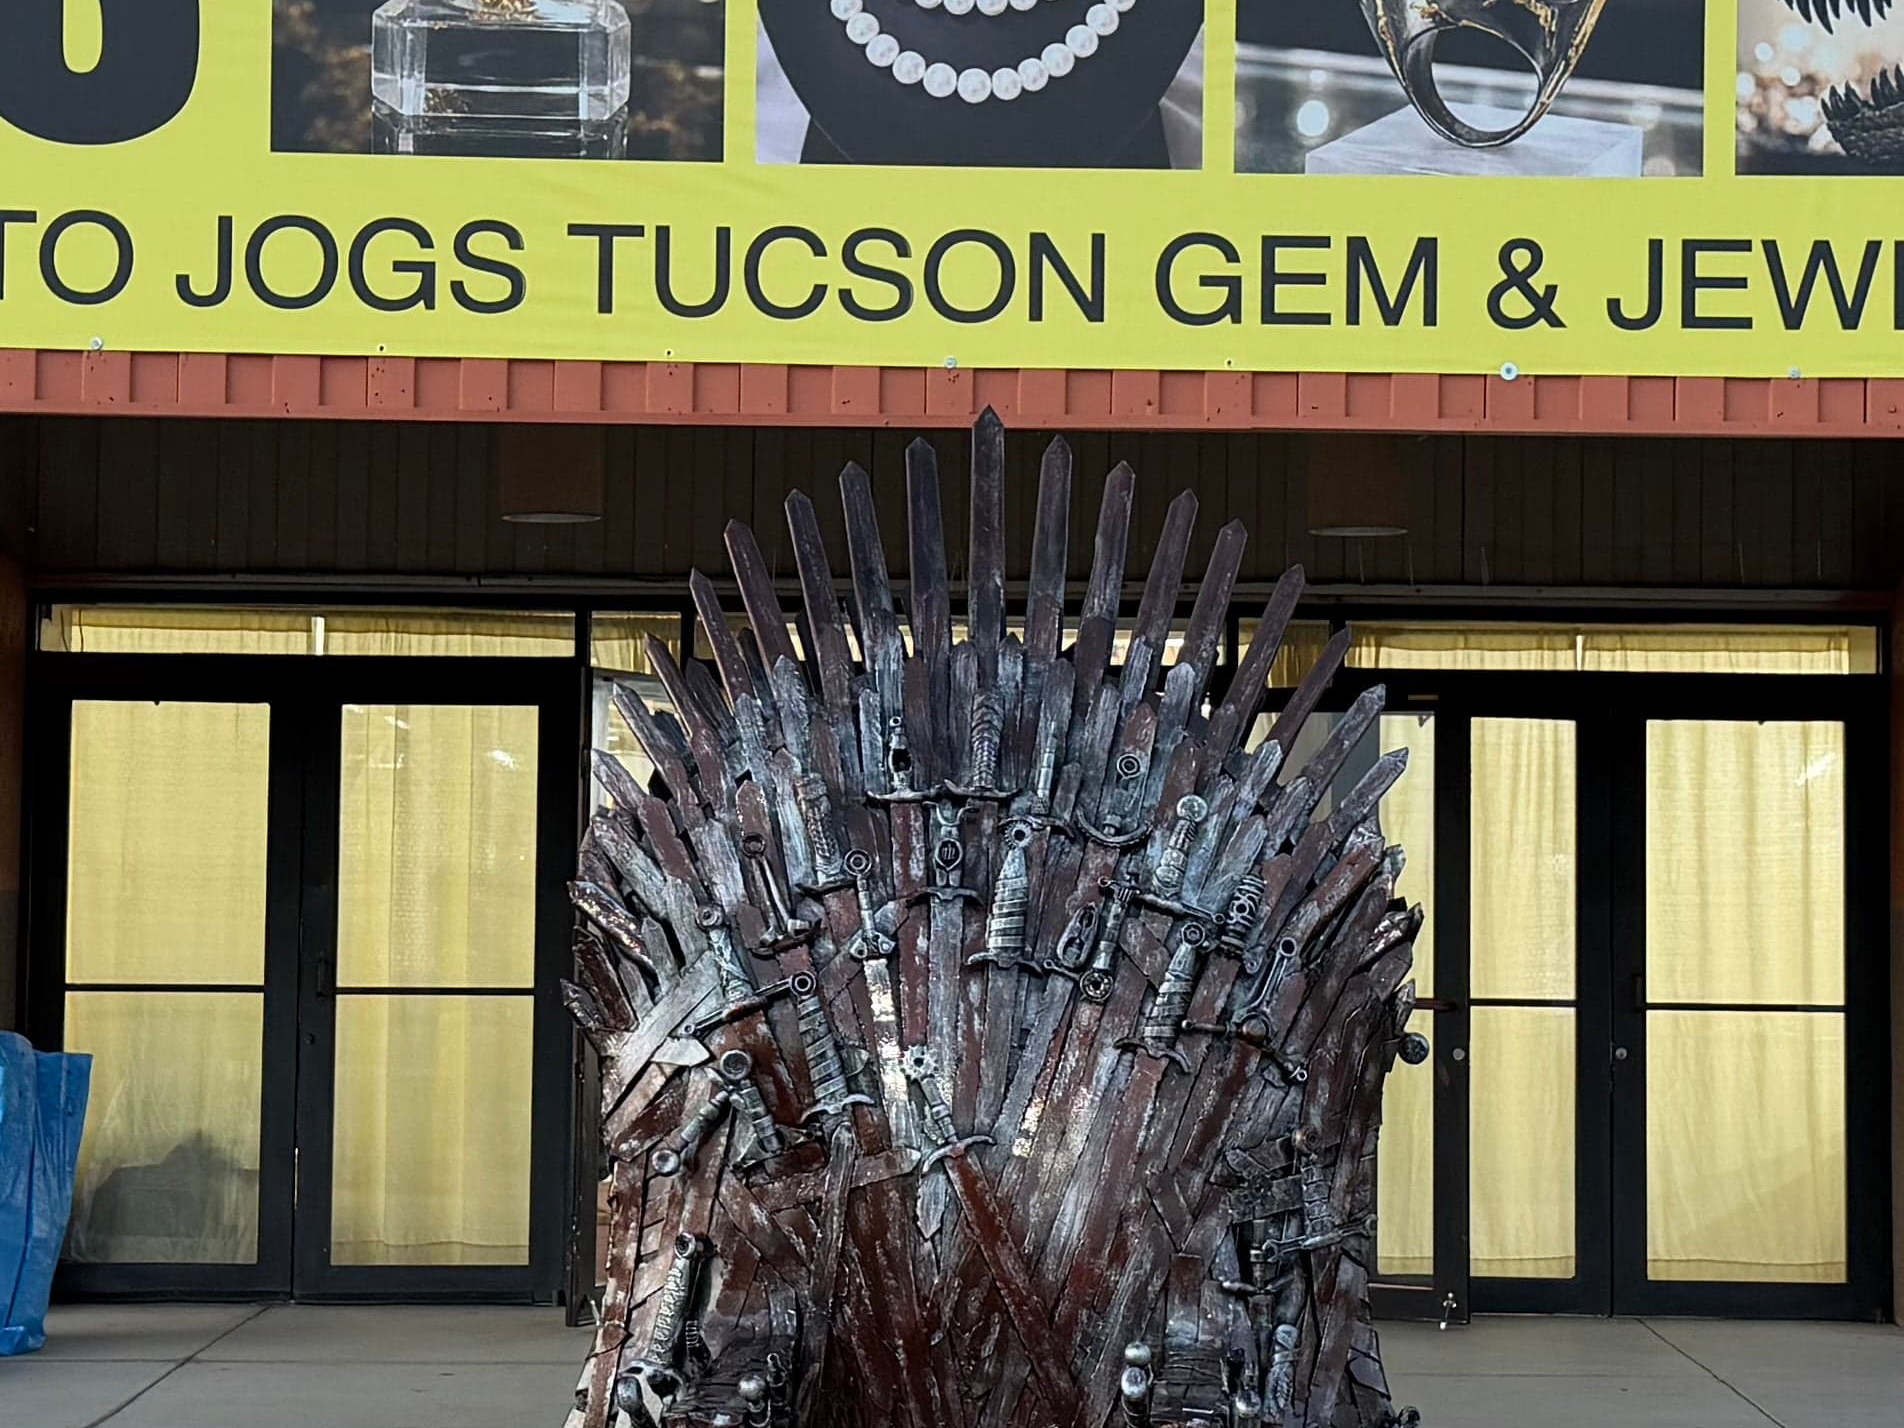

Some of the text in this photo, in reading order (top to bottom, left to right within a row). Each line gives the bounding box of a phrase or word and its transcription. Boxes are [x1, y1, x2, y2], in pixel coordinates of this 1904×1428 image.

[175, 214, 527, 314] JOGS
[567, 223, 1106, 324] TUCSON
[1155, 232, 1438, 327] GEM
[1486, 237, 1567, 330] &
